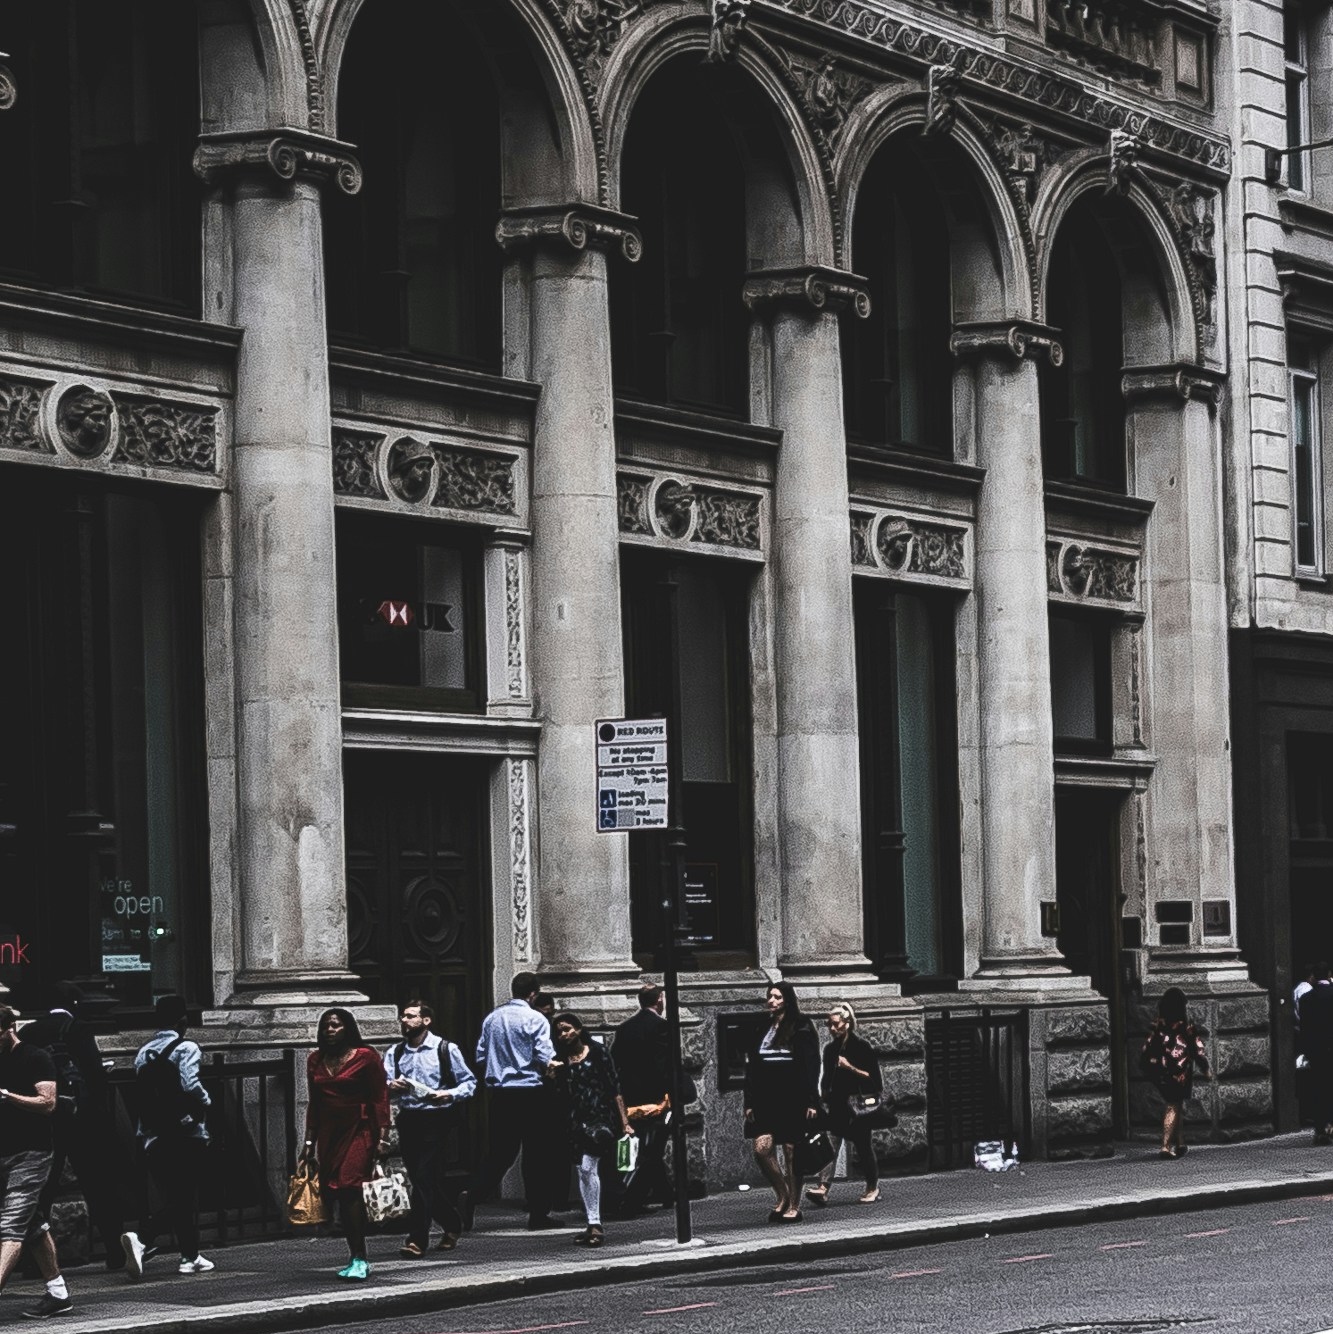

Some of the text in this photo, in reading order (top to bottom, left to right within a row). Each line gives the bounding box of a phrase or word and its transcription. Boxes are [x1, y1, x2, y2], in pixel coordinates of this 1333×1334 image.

[617, 726, 664, 736] RED ROUTE
[114, 895, 164, 920] open
